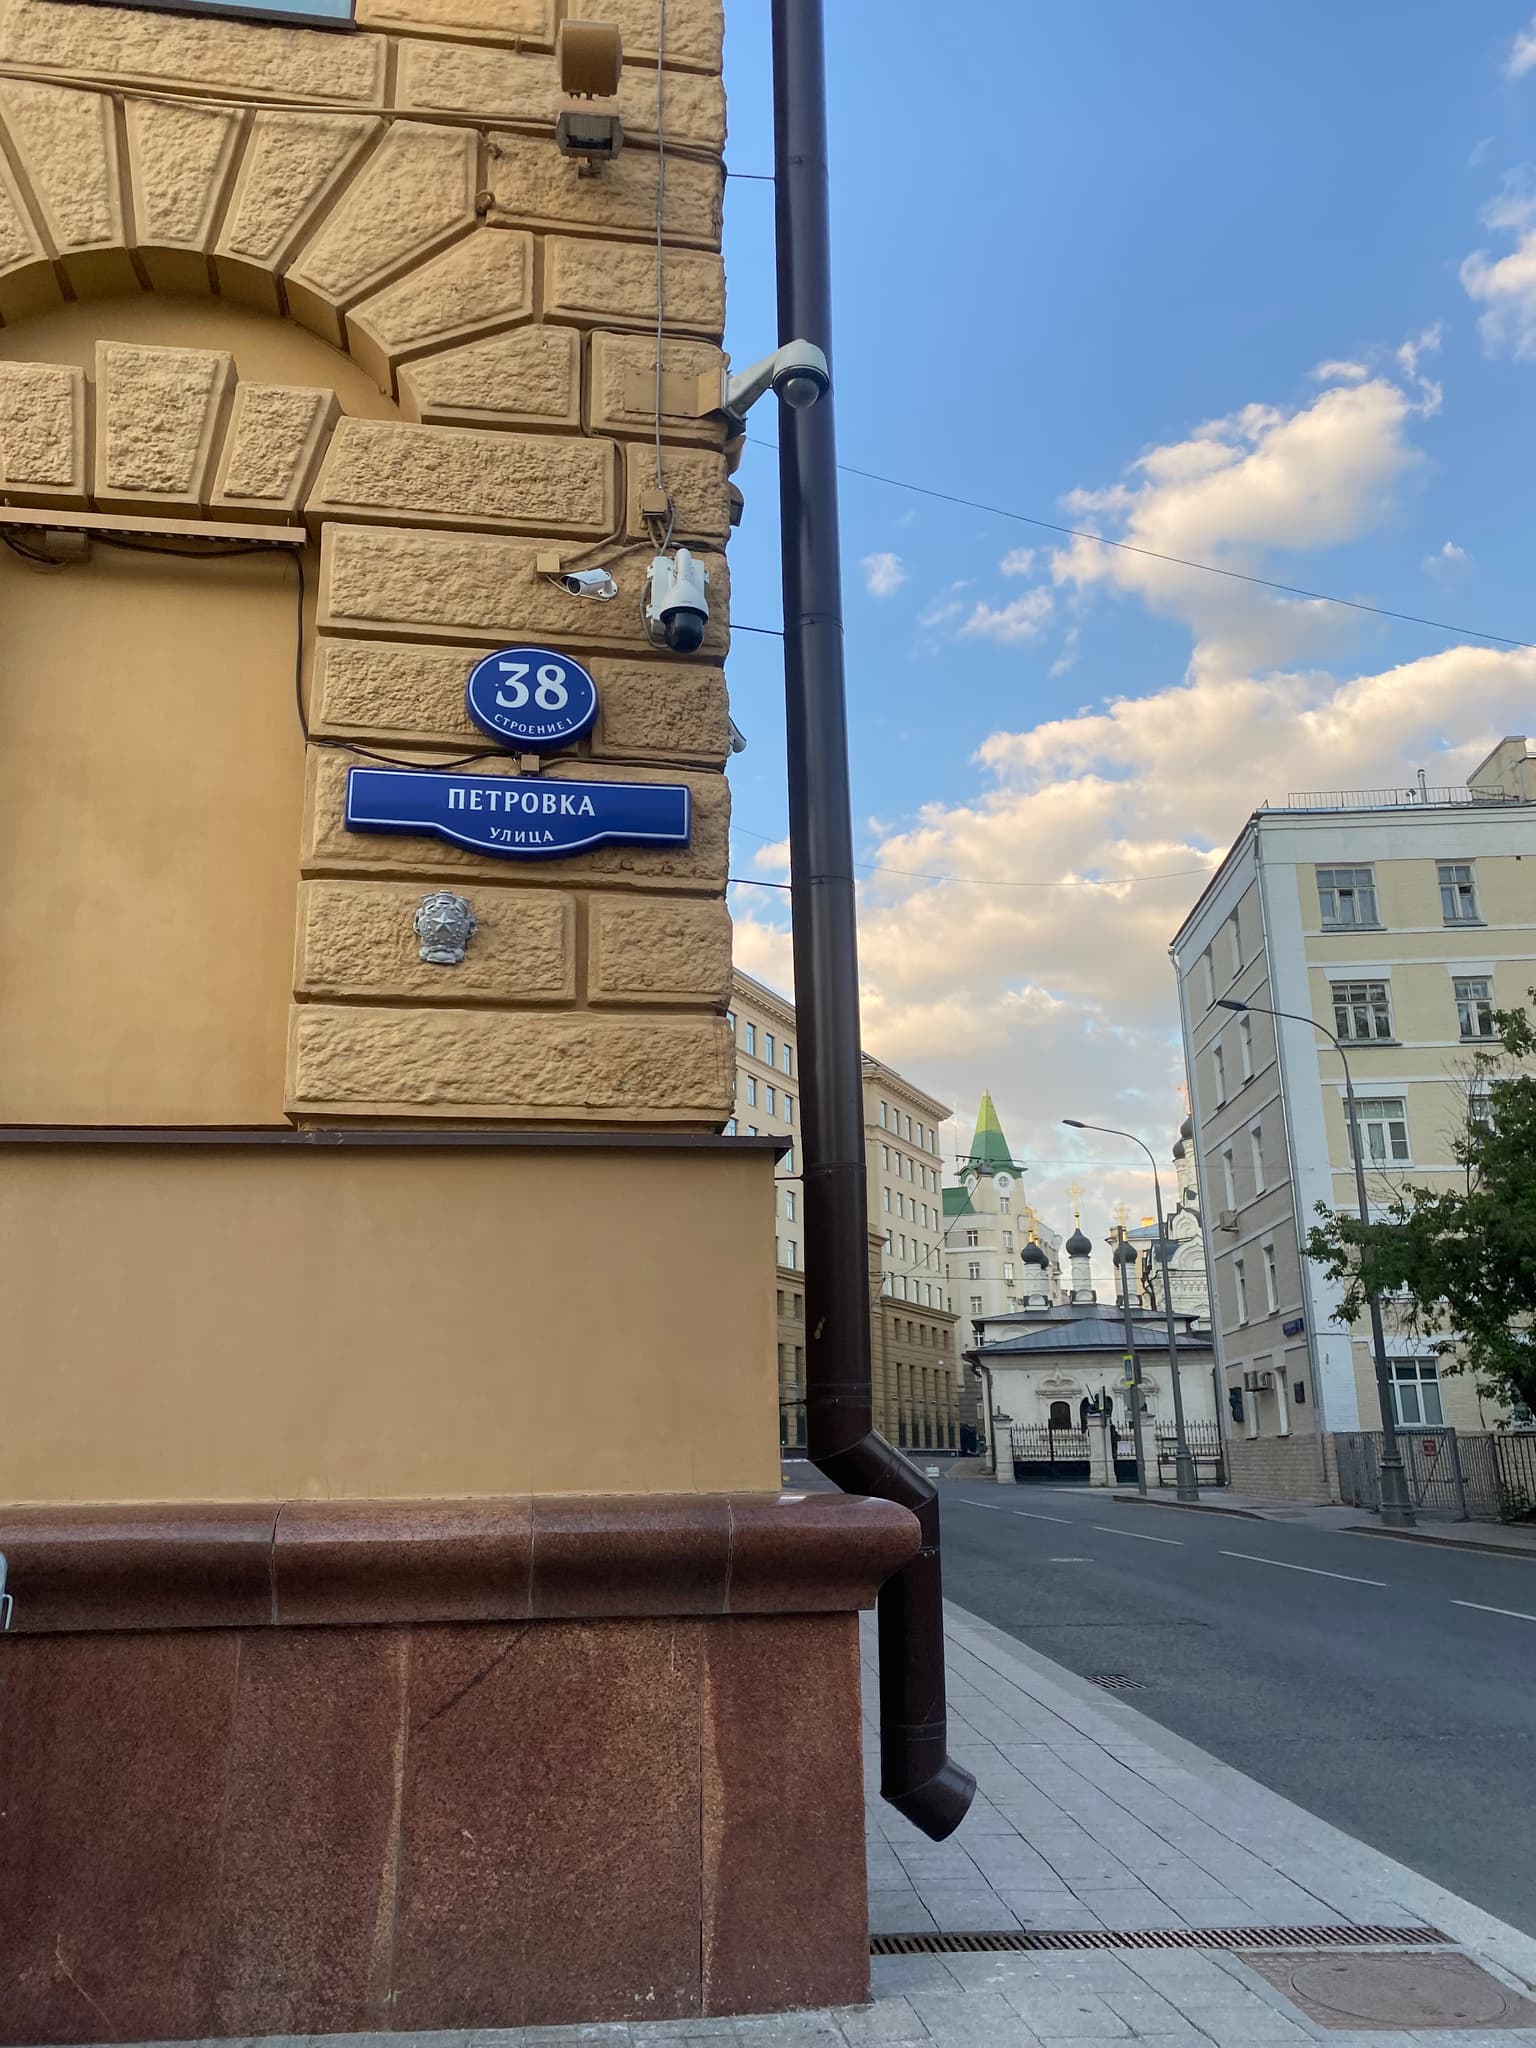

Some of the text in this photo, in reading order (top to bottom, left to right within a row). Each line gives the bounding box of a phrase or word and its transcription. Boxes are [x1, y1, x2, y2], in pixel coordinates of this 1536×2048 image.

[495, 661, 568, 710] 38
[494, 713, 573, 734] СТРОЕНИЕ 1
[448, 788, 596, 817] ПЕТРОВКА
[490, 827, 554, 844] УЛИЦА
